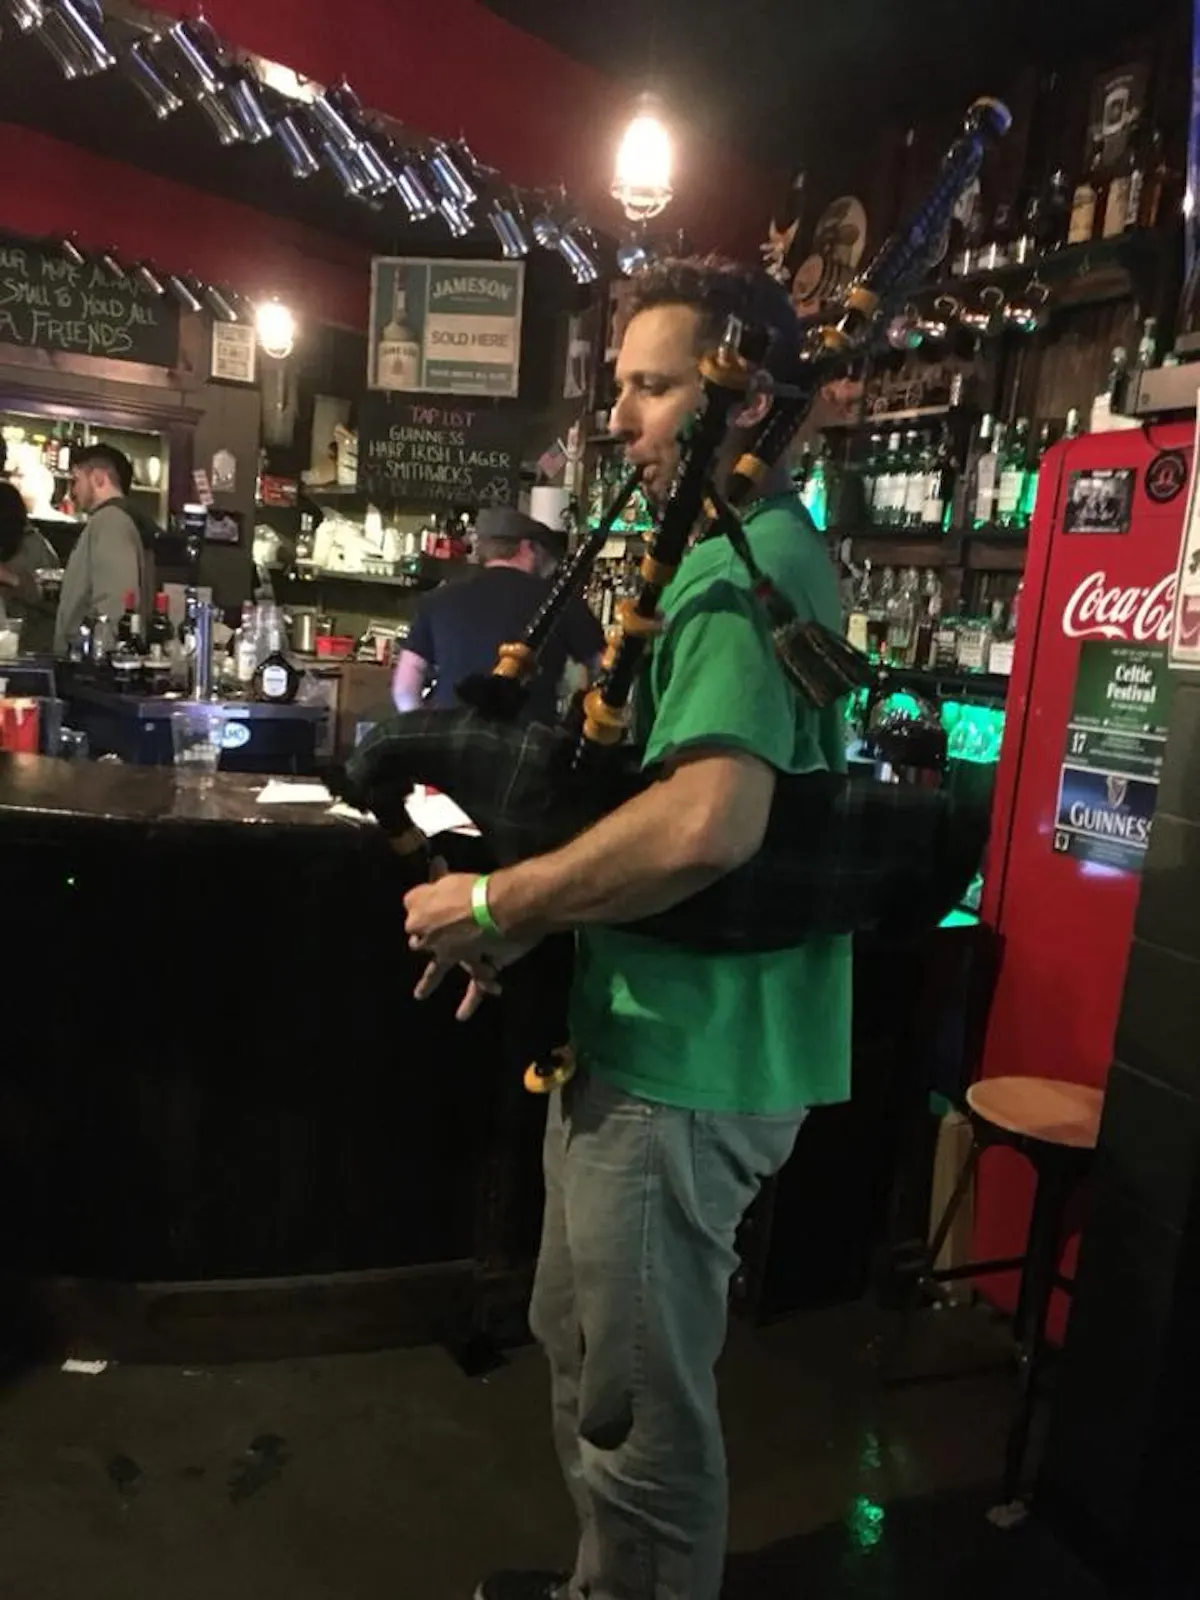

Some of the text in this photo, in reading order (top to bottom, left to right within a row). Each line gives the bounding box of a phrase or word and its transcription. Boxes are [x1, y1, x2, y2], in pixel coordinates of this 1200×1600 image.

[432, 277, 512, 301] JAMESON
[31, 309, 133, 353] FRIENDS
[431, 329, 509, 348] SOLD HERE
[410, 405, 440, 424] TAP
[389, 425, 465, 446] GUINNESS
[368, 439, 404, 459] HARP
[459, 448, 511, 469] LAGER
[1115, 664, 1153, 684] Celtic
[1106, 681, 1157, 704] Festival
[1072, 731, 1087, 754] 17
